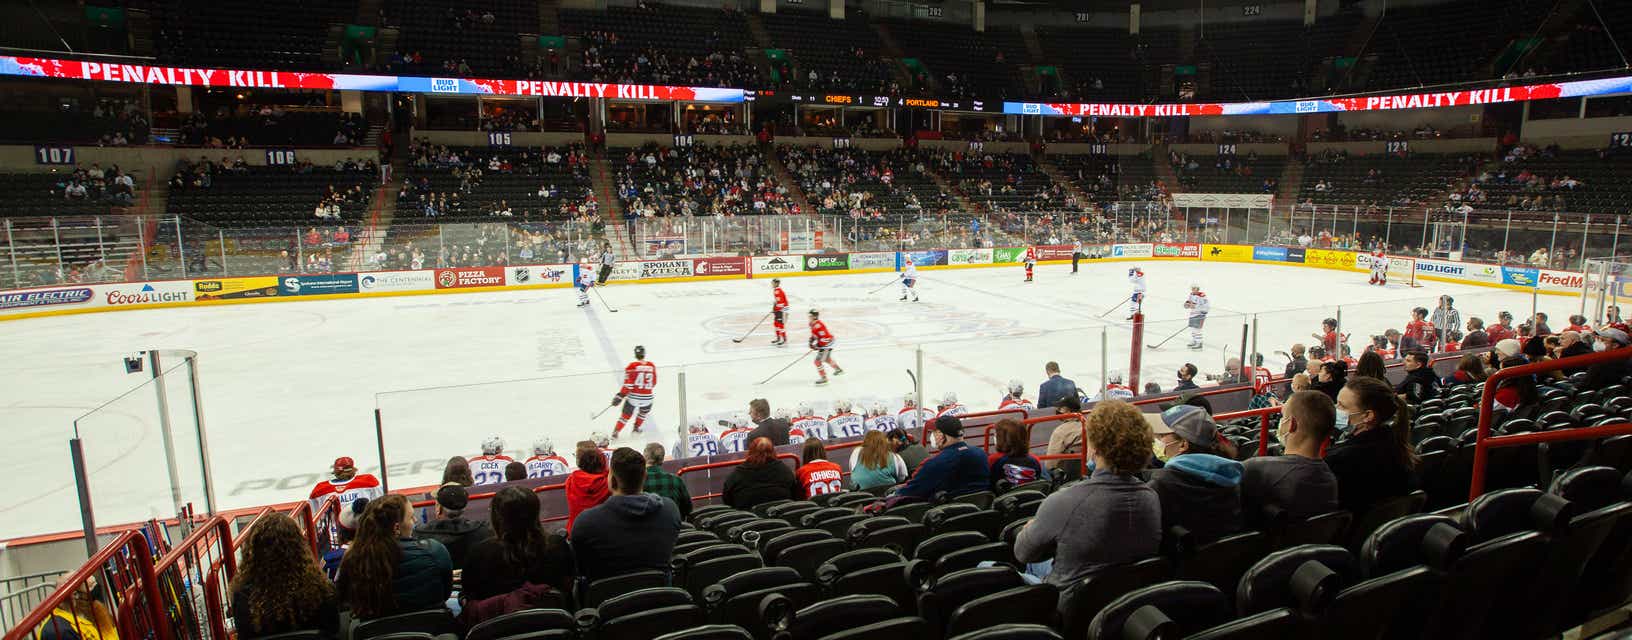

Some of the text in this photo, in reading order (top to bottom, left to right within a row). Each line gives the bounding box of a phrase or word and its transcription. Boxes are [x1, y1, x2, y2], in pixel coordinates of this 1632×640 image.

[82, 61, 285, 88] PENALTY KILL
[436, 78, 453, 86] BUD
[516, 80, 659, 99] PENALTY KILL
[858, 96, 863, 104] 1
[898, 98, 938, 107] 4 PORTLAND
[1366, 87, 1515, 110] PENALTY KILL
[1079, 103, 1190, 116] PENALTY KILL
[490, 133, 511, 145] 105
[675, 135, 692, 146] 104
[834, 139, 849, 148] 103
[970, 142, 983, 151] 102
[1092, 145, 1106, 154] 101
[1219, 144, 1236, 154] 124
[39, 148, 71, 163] 107
[268, 151, 294, 165] 106
[641, 267, 690, 278] AZTECA
[1416, 262, 1434, 272] BUD
[1435, 264, 1464, 274] LIGHT
[459, 276, 501, 285] FACTORY
[27, 289, 89, 301] ELECTRIC
[106, 290, 188, 305] Coors LIGHT
[634, 373, 654, 390] 43
[842, 424, 861, 437] 15
[692, 440, 717, 456] 28
[481, 462, 499, 470] CICEK
[809, 470, 842, 482] JOHNSON
